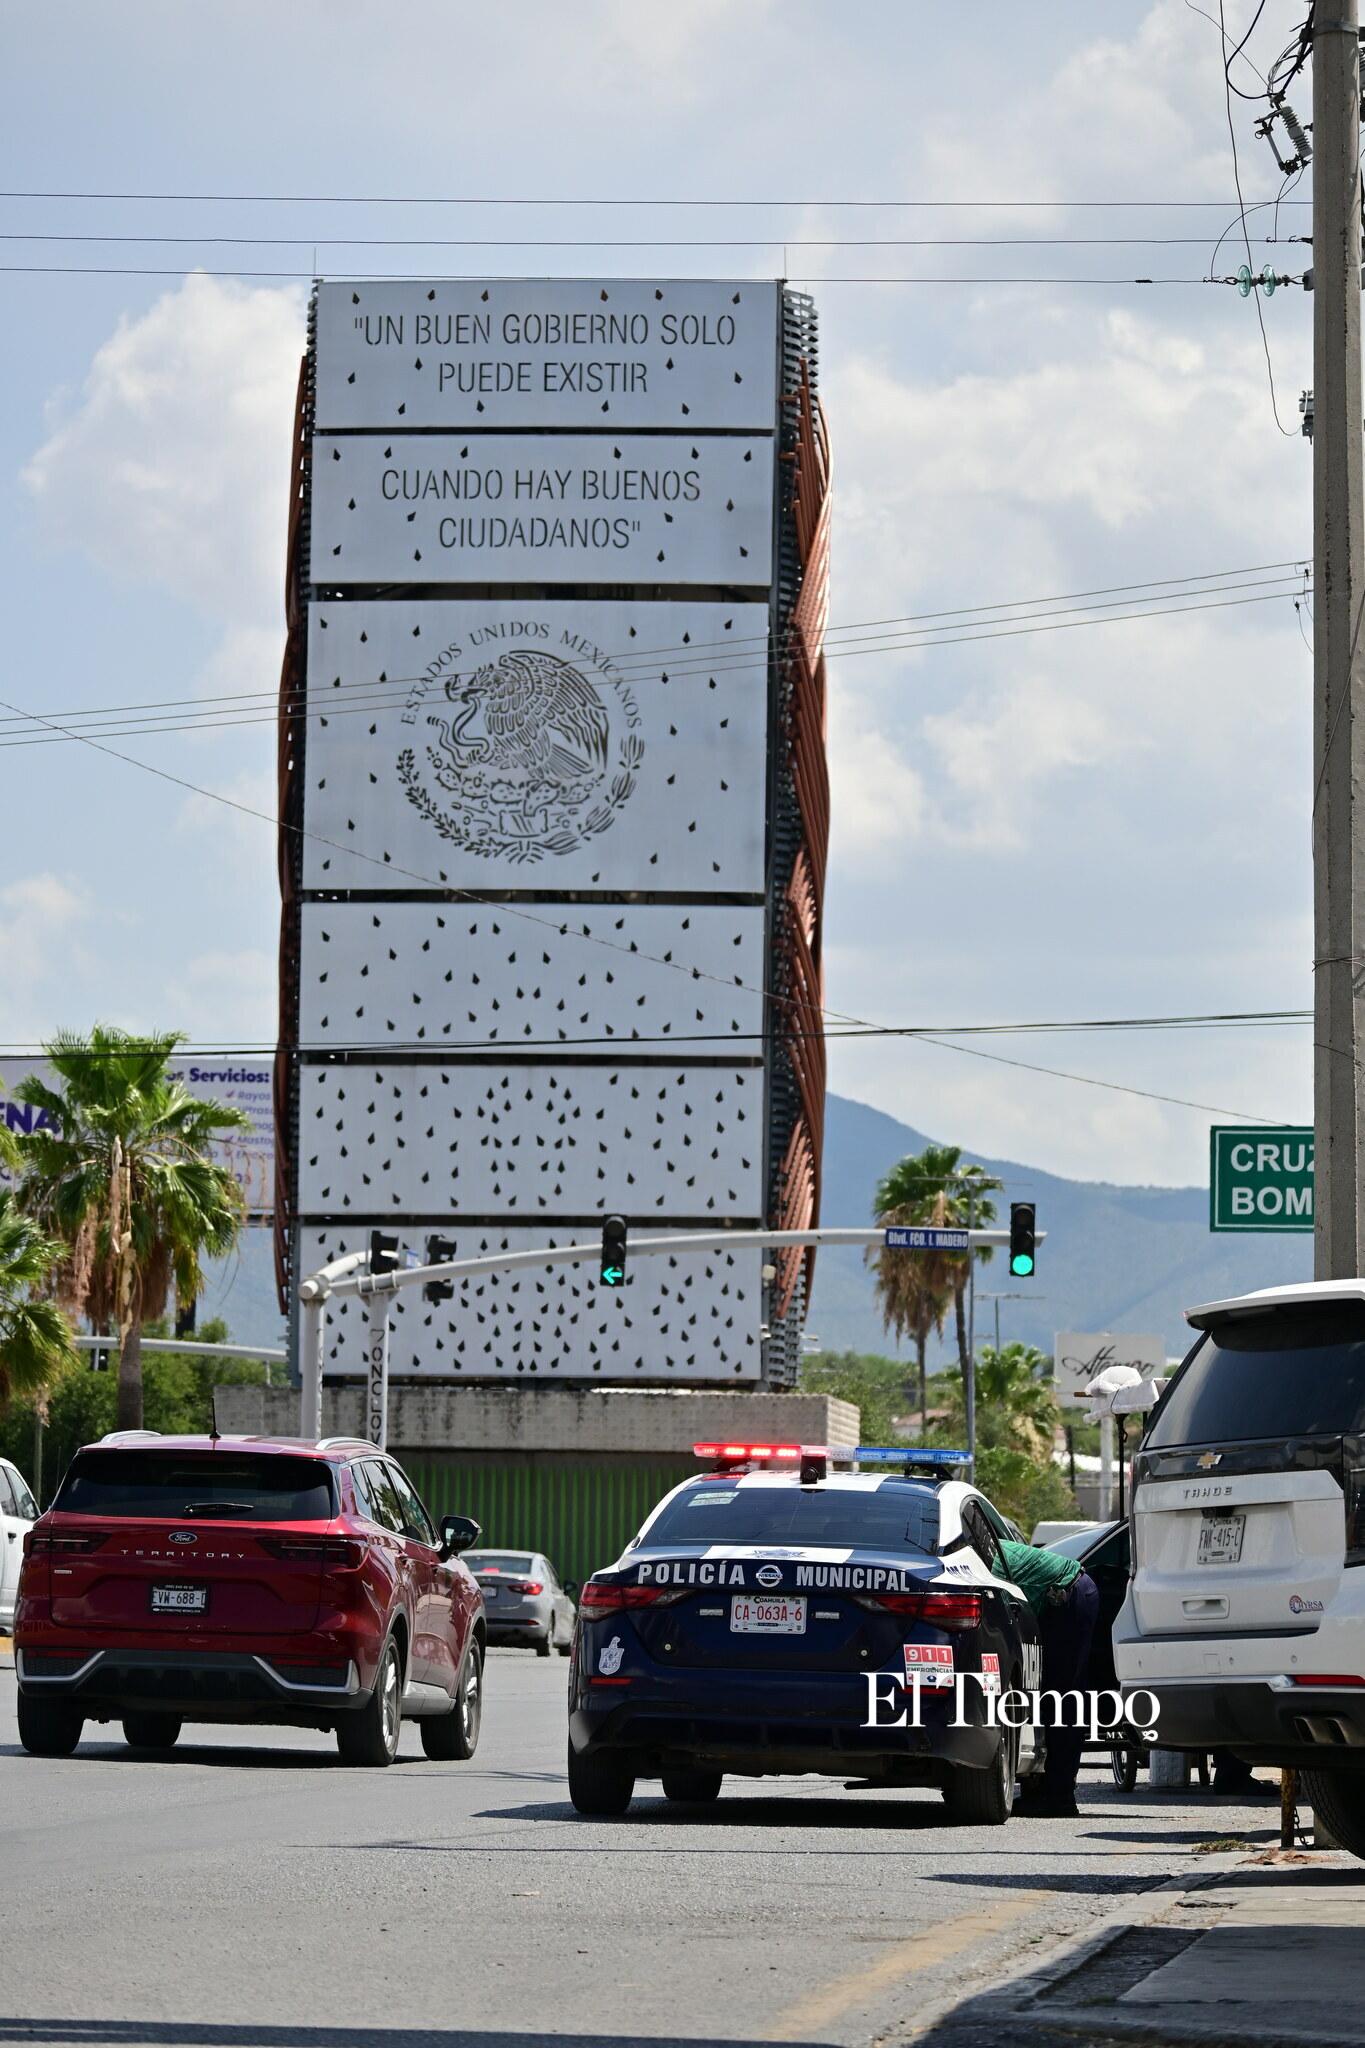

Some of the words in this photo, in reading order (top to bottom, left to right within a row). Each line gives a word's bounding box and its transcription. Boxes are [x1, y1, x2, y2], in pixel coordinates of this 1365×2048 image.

[354, 314, 403, 345] "UN
[415, 314, 490, 344] BUEN
[502, 313, 649, 345] GOBIERNO
[660, 314, 736, 345] SOLO
[439, 362, 532, 392] PUEDE
[543, 362, 648, 392] EXISTIR
[381, 469, 503, 500] CUANDO
[514, 470, 572, 500] HAY
[582, 470, 701, 501] BUENOS
[439, 517, 642, 549] CIUDADANOS"
[401, 642, 462, 725] ESTADOS
[469, 621, 550, 646] UNIDOS
[559, 629, 642, 728] MEXICANOS
[189, 1067, 270, 1083] Servicios:
[1231, 1186, 1313, 1216] BOM
[888, 1231, 908, 1245] Blvd.
[935, 1233, 968, 1248] MADERO
[1183, 1486, 1233, 1499] TAHOE
[121, 1549, 245, 1559] TERRITORY
[637, 1560, 745, 1586] POLICÍA
[796, 1565, 910, 1592] MUNICIPAL
[735, 1604, 803, 1621] CA-063A-6
[753, 1596, 786, 1604] COAHUILA
[908, 1648, 949, 1662] 911
